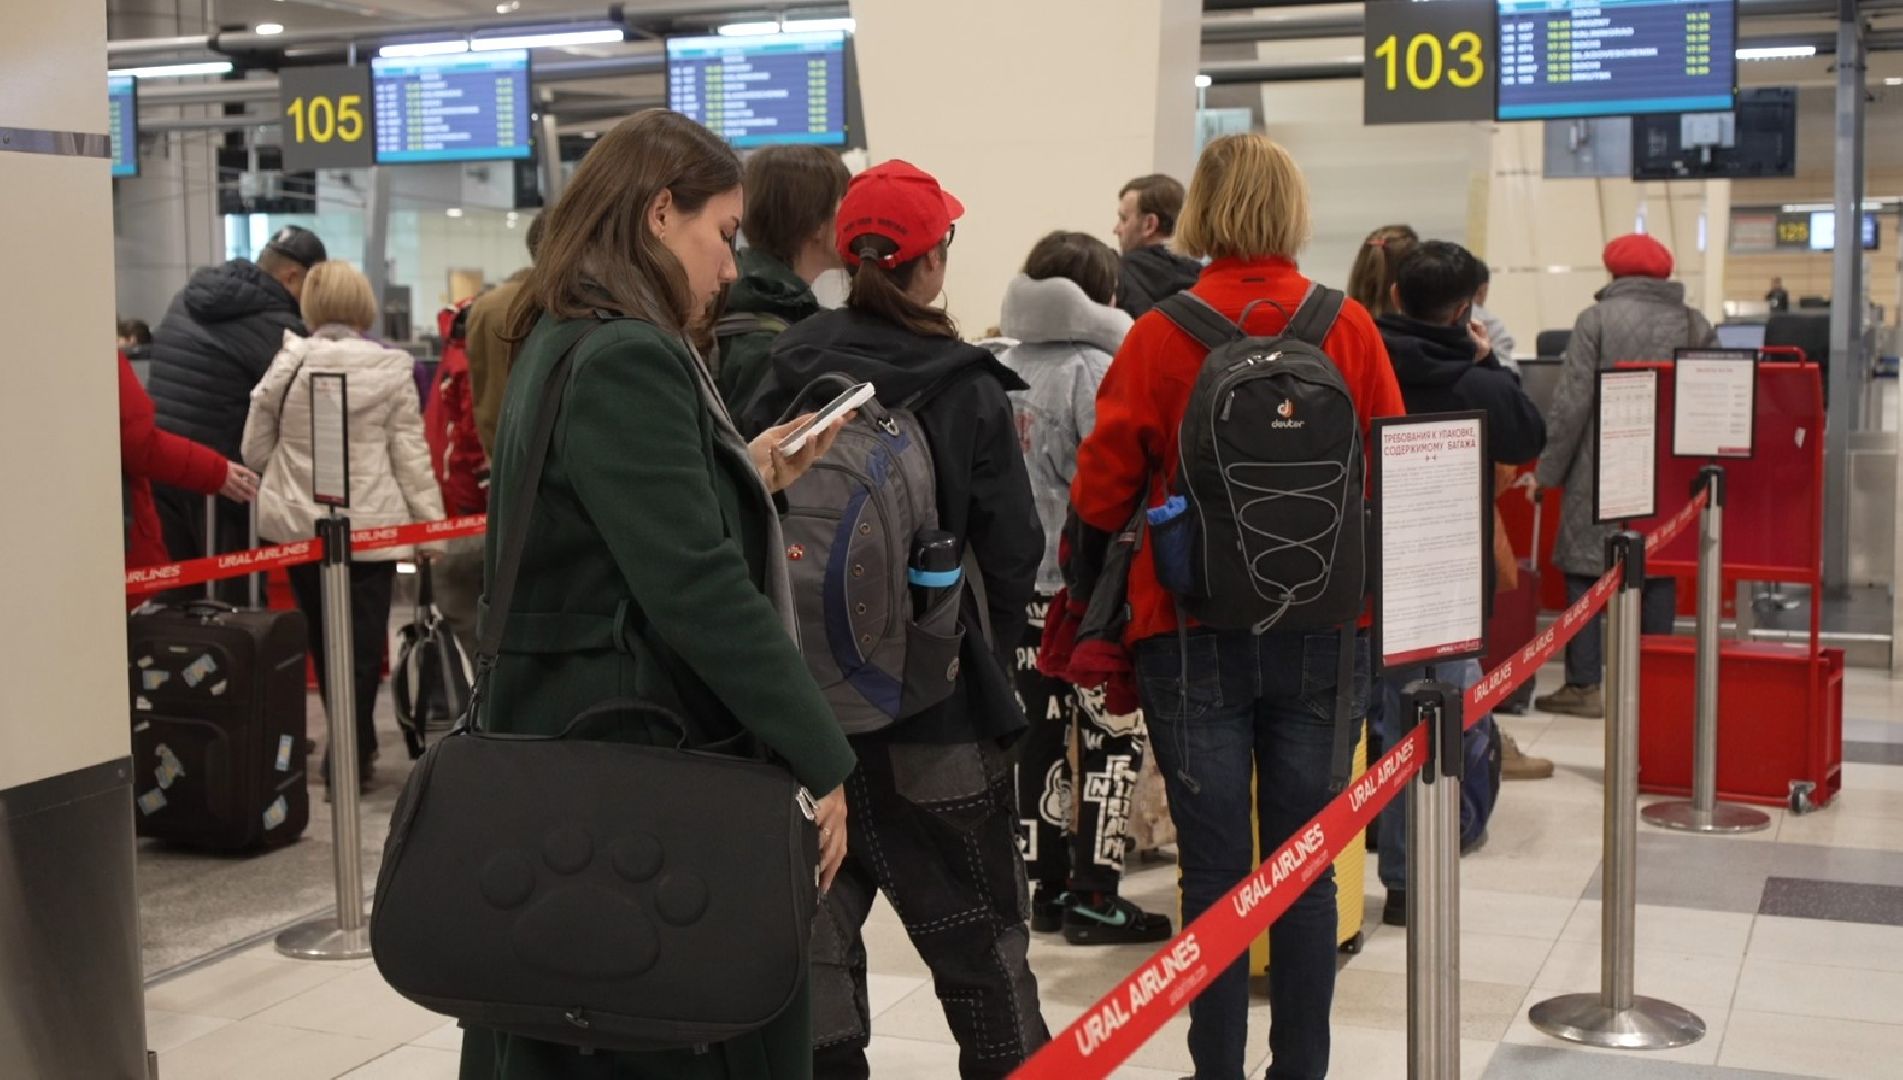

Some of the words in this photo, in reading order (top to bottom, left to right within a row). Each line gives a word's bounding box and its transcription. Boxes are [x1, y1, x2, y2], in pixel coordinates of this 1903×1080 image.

[1375, 31, 1484, 90] 103
[287, 95, 363, 143] 105
[1271, 419, 1305, 429] deuter
[126, 564, 180, 584] IRLINES
[218, 552, 255, 568] URAL
[255, 542, 309, 561] AIRLINES
[1473, 679, 1490, 704] URAL
[1489, 660, 1512, 690] AIRLINES
[1348, 775, 1378, 812] URAL
[1377, 736, 1414, 789] AIRLINES
[1231, 872, 1273, 918] URAL
[1271, 822, 1325, 889] AIRLINES
[1074, 997, 1131, 1057] URAL
[1128, 933, 1200, 1014] AIRLINES
